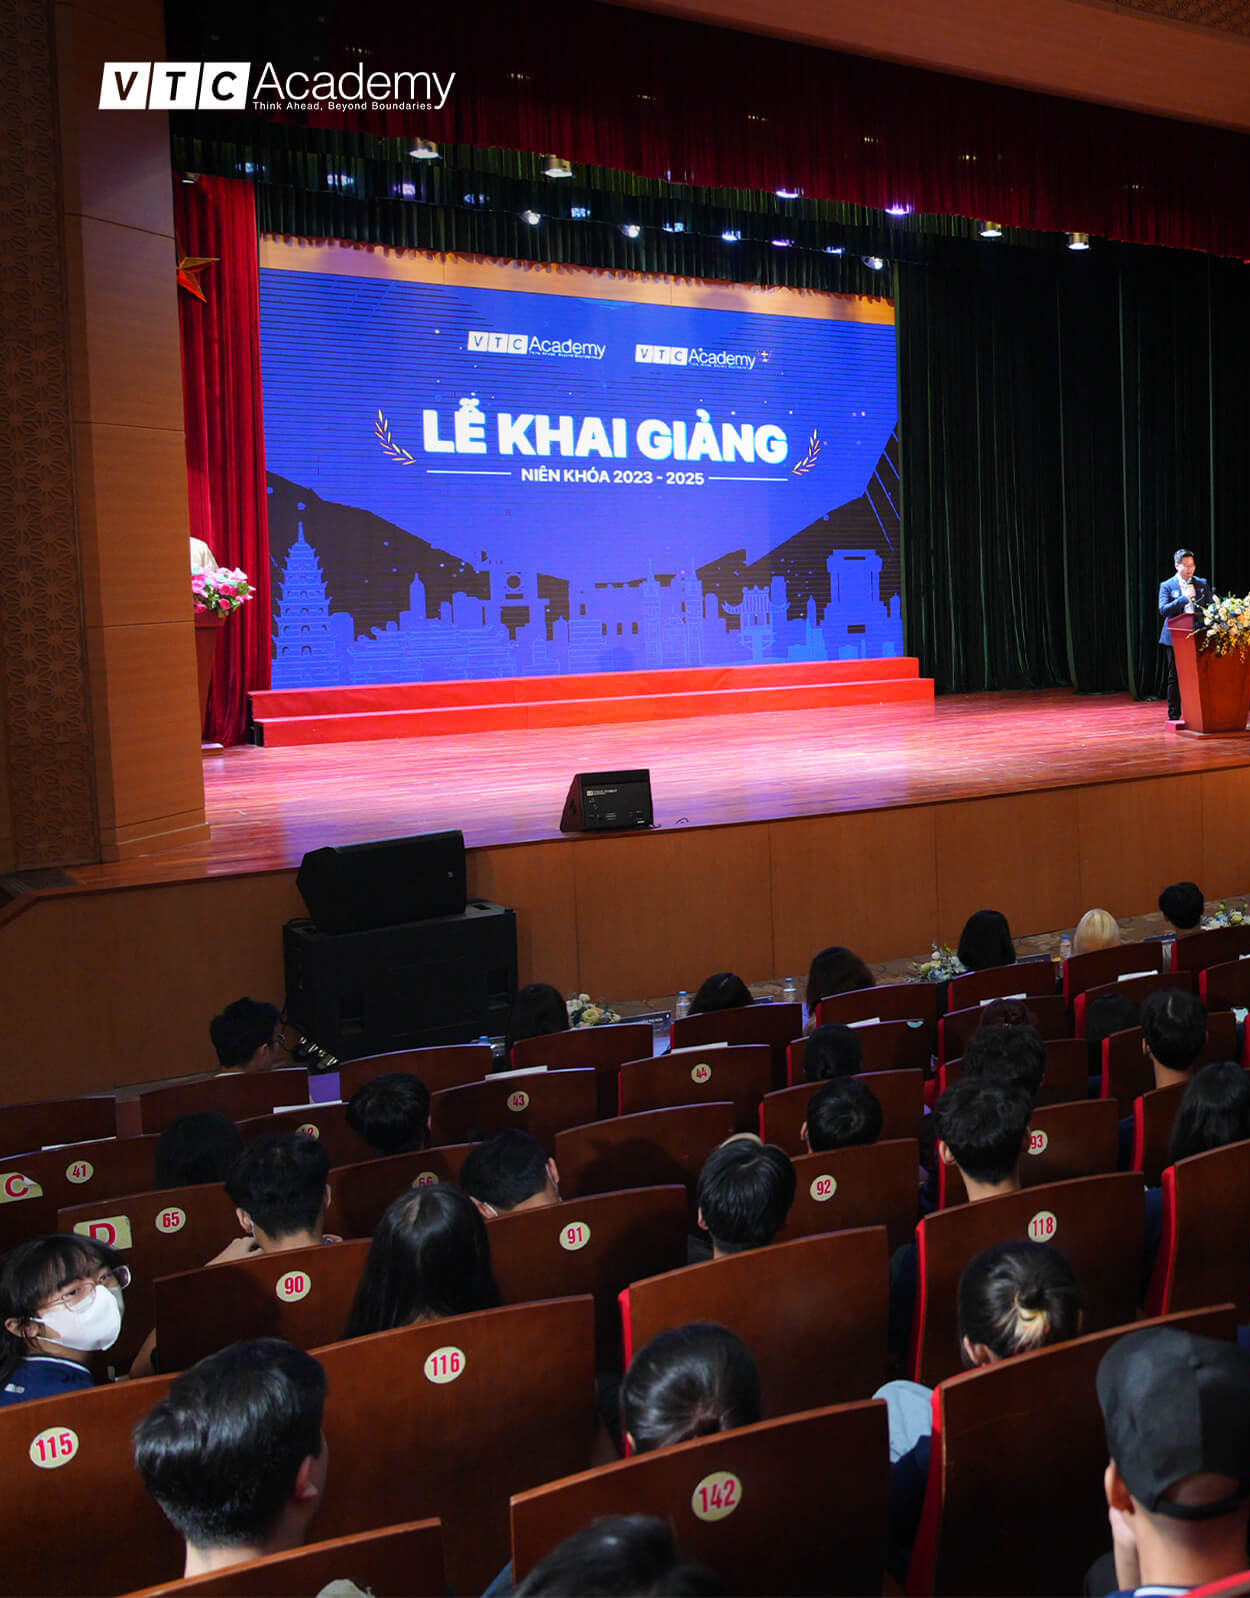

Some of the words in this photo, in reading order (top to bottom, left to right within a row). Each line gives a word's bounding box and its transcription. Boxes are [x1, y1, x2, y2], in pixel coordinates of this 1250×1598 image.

[472, 334, 524, 351] VTC
[529, 335, 607, 359] Academy
[639, 347, 685, 363] VTC
[422, 397, 488, 454] LỄ
[497, 412, 627, 458] KHAI
[636, 408, 788, 464] GIẢNG
[521, 465, 561, 482] NIÊN
[564, 466, 611, 484] KHÓA
[613, 470, 653, 484] 2023
[666, 472, 705, 486] 2025
[695, 1066, 708, 1079] 44
[512, 1094, 525, 1108] 43
[1030, 1134, 1043, 1150] 93
[73, 1164, 87, 1178] 41
[5, 1174, 30, 1198] C
[816, 1179, 832, 1196] 92
[162, 1212, 180, 1228] 65
[1032, 1216, 1054, 1237] 118
[89, 1222, 116, 1247] D
[567, 1227, 583, 1244] 91
[284, 1275, 305, 1295] 90
[430, 1352, 460, 1377] 116
[36, 1432, 73, 1461] 115
[699, 1479, 737, 1512] 142
